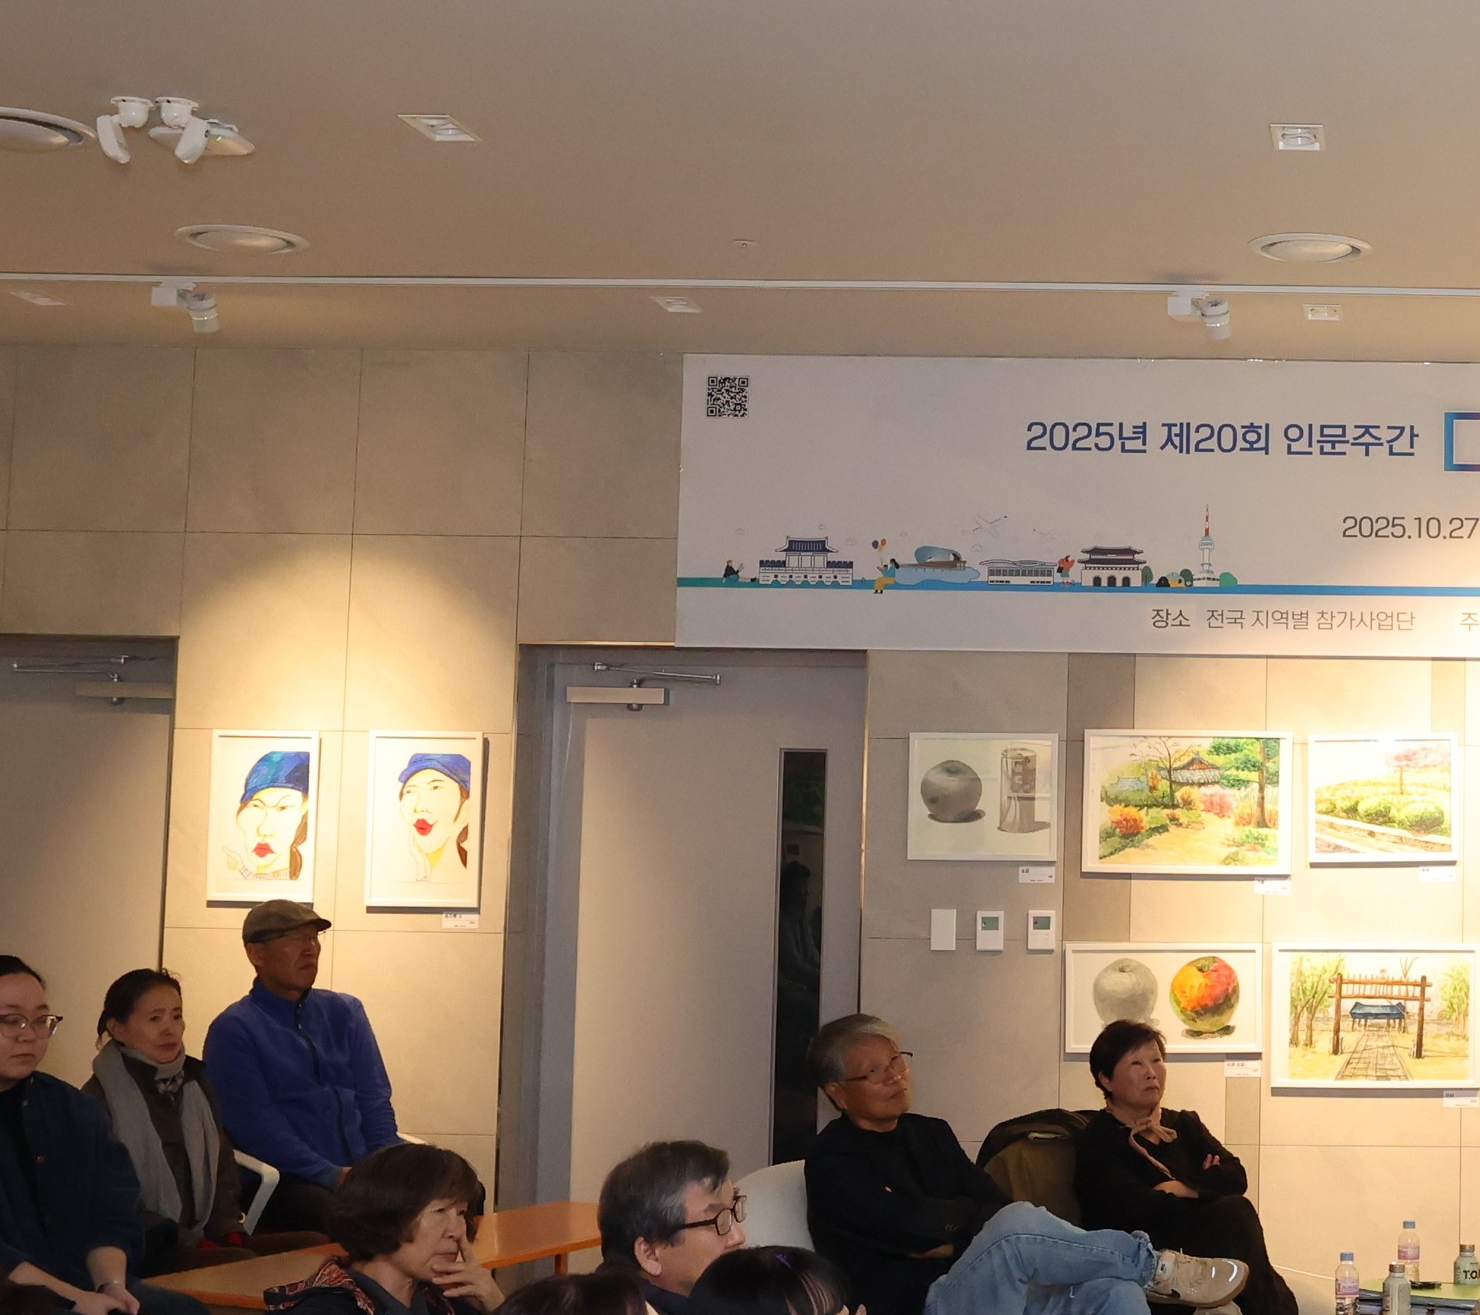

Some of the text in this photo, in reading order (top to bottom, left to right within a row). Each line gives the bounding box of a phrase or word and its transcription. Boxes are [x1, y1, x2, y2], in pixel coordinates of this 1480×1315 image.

[1026, 420, 1419, 457] 2025년 제20회 인문주간
[1150, 607, 1416, 633] 장소 전국 지역별 참가사업단
